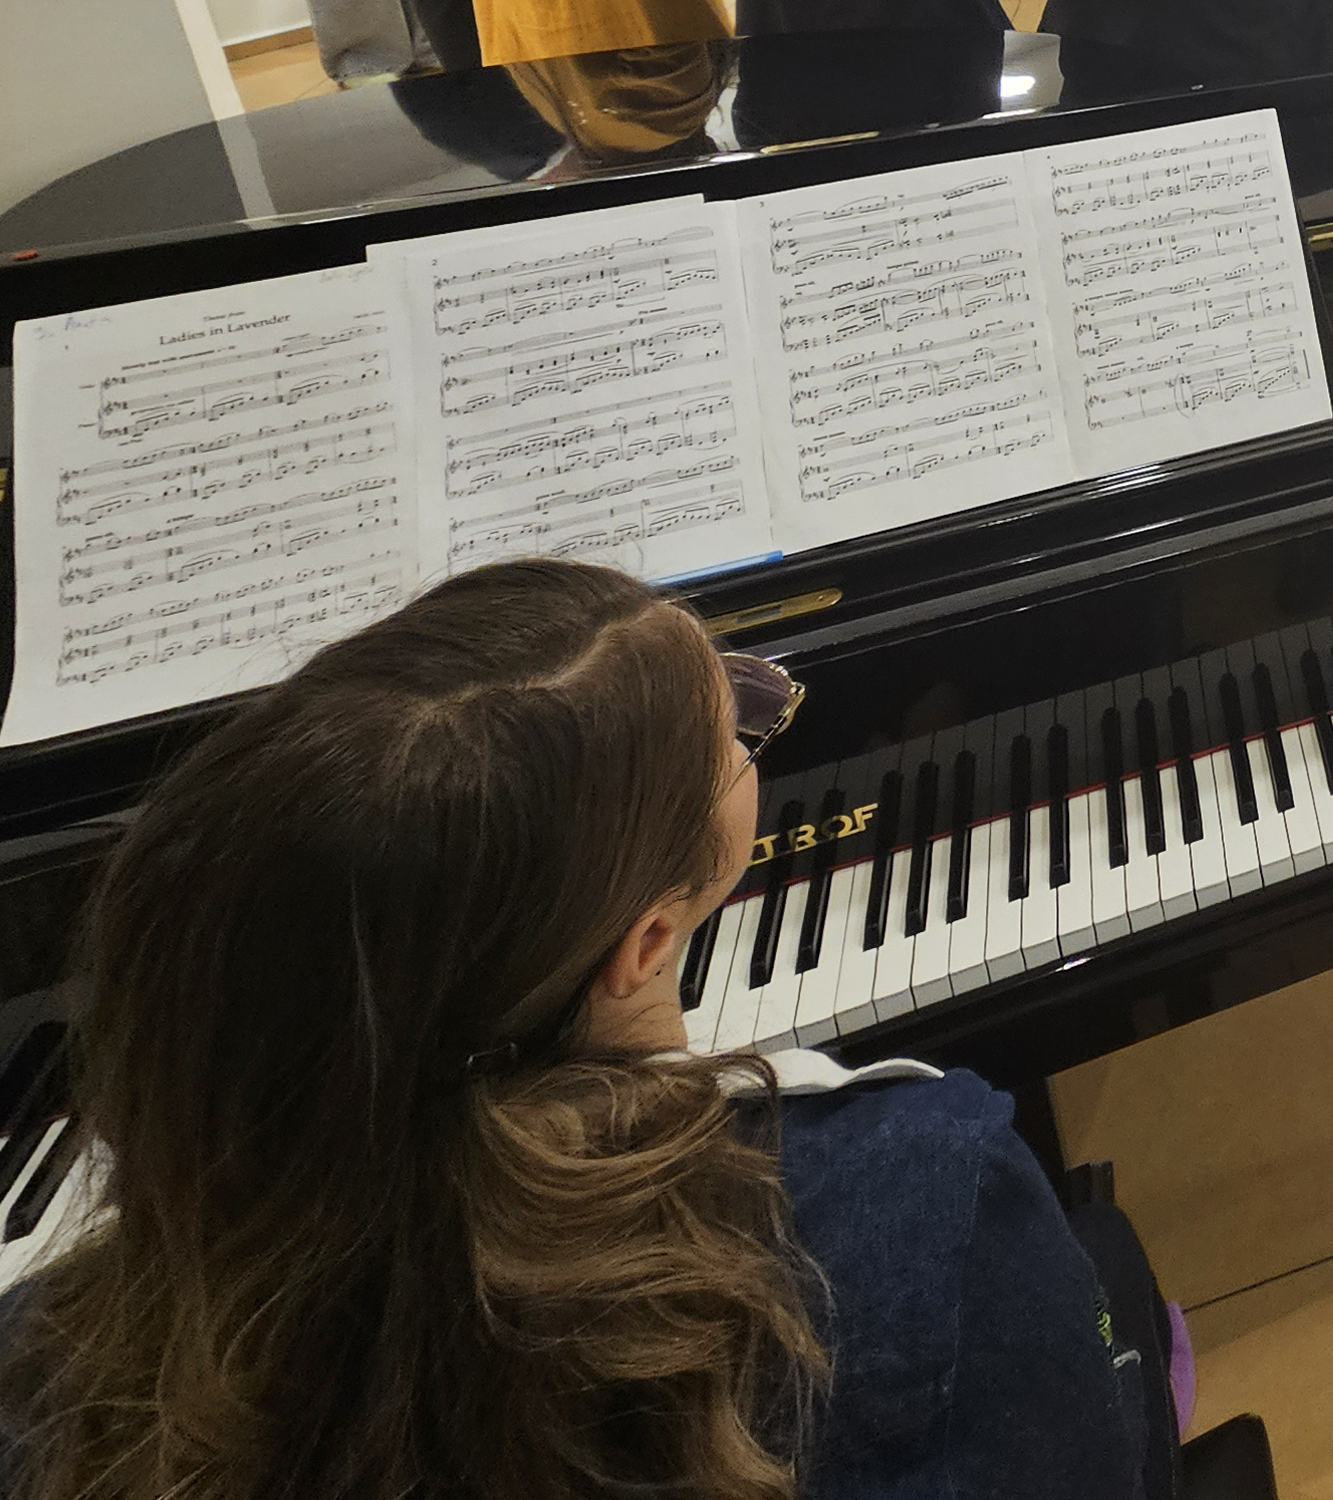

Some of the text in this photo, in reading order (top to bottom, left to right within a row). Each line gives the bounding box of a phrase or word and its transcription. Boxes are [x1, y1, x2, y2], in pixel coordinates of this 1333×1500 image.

[159, 331, 206, 346] Ladies
[209, 326, 224, 336] in
[227, 313, 291, 333] Lavender
